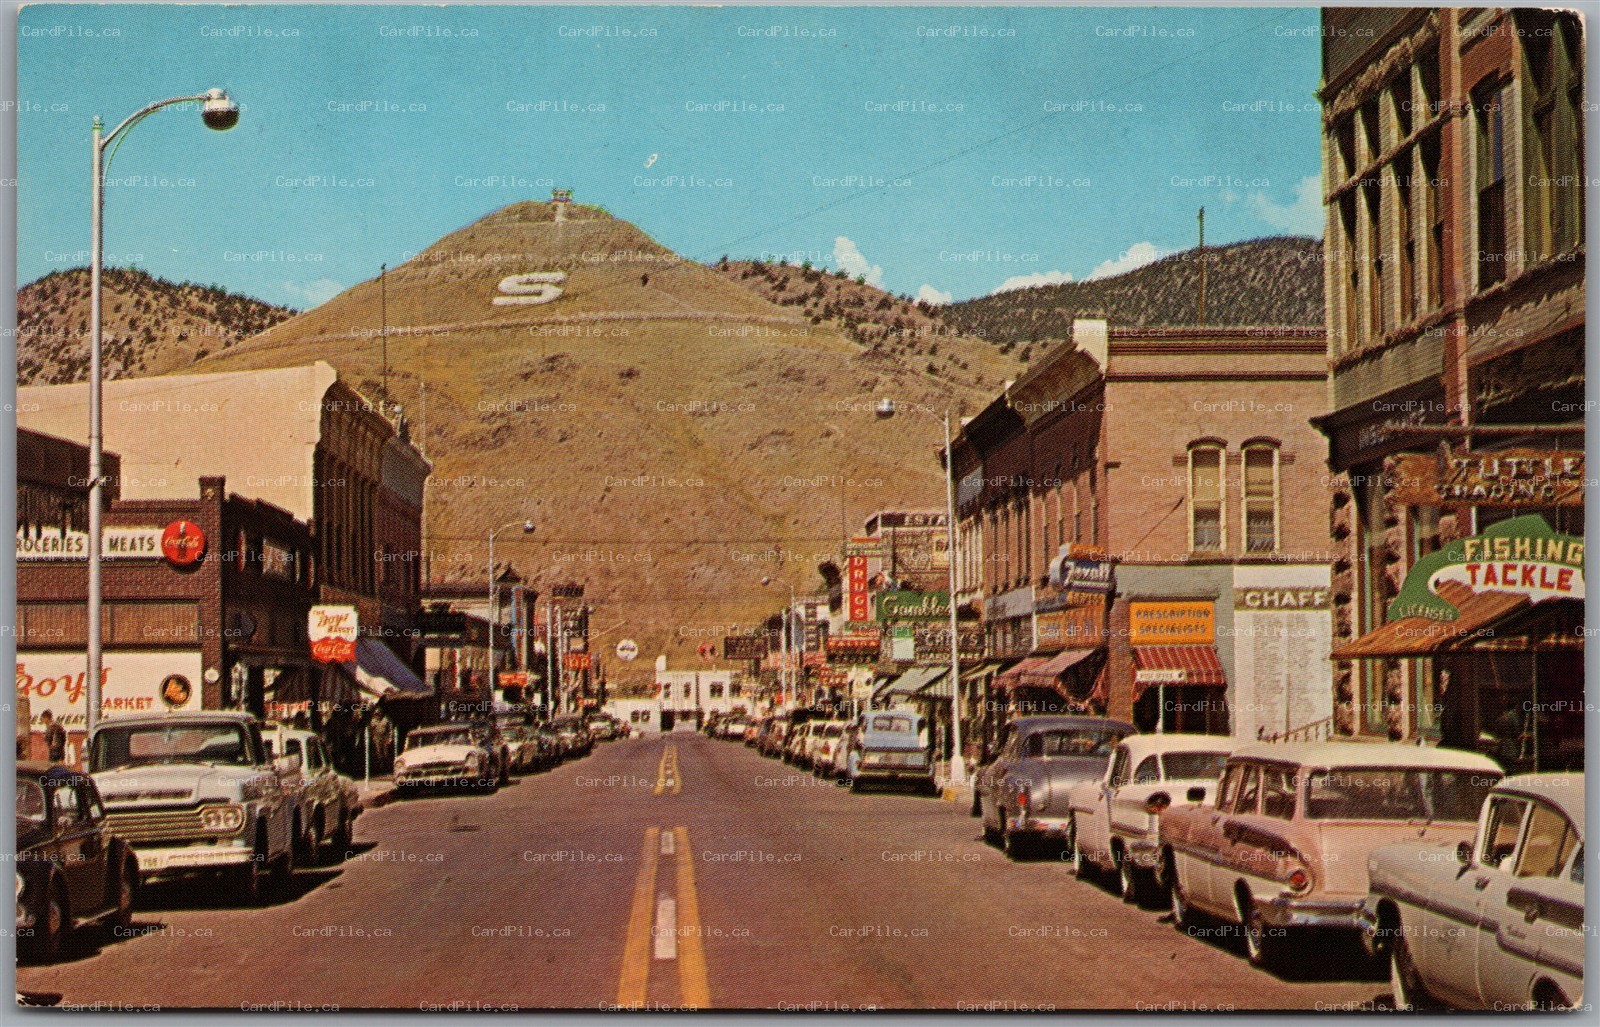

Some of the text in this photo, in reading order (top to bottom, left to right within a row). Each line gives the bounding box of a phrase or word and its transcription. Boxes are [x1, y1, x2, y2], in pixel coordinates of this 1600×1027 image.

[1453, 457, 1584, 480] TUTTLE
[108, 537, 156, 552] MEATS
[1463, 537, 1585, 566] FISHING
[853, 557, 865, 618] DRUGS
[1465, 563, 1574, 592] TACKLE
[1245, 591, 1329, 608] CHAFF
[1135, 608, 1211, 619] PRESCRIPTION
[1138, 624, 1207, 635] SPECIALISTS
